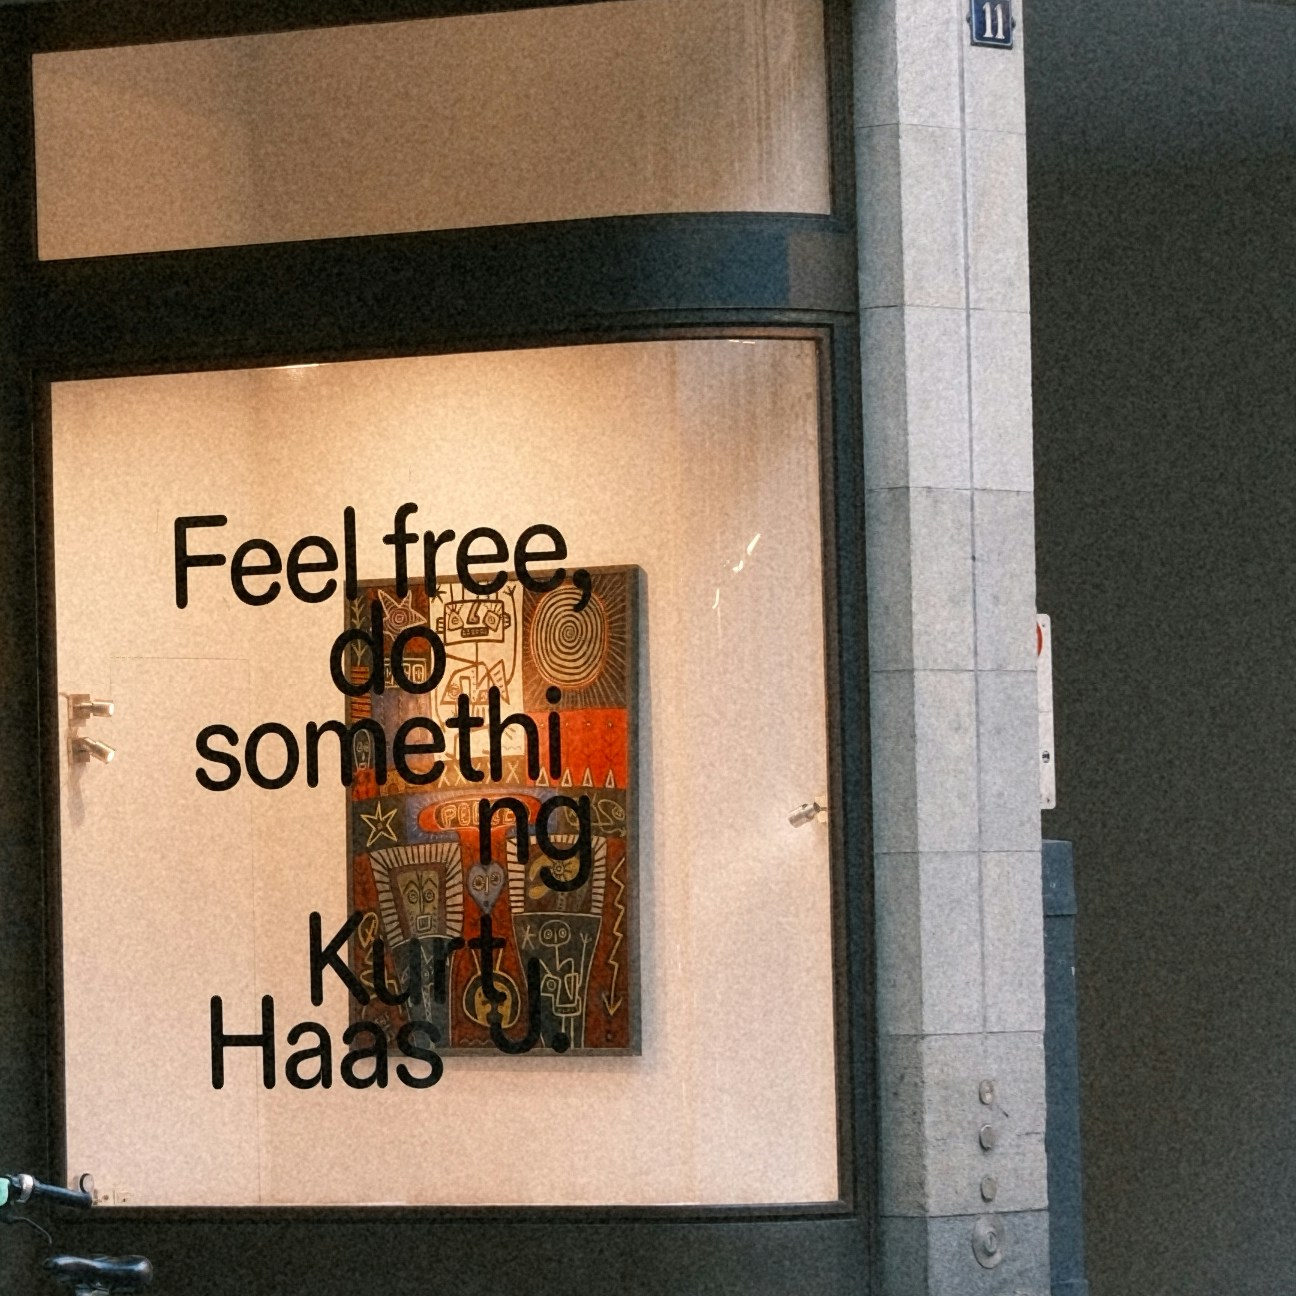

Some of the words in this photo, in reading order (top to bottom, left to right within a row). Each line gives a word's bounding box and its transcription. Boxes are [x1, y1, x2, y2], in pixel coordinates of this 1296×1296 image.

[982, 1, 1005, 39] 11
[174, 506, 357, 609] Feel
[382, 502, 593, 612] free,
[329, 599, 447, 698] do
[195, 686, 563, 791] somethi
[478, 793, 593, 892] ng
[309, 911, 507, 1007] Kurt
[488, 956, 571, 1054] J.
[210, 995, 444, 1090] Haas
